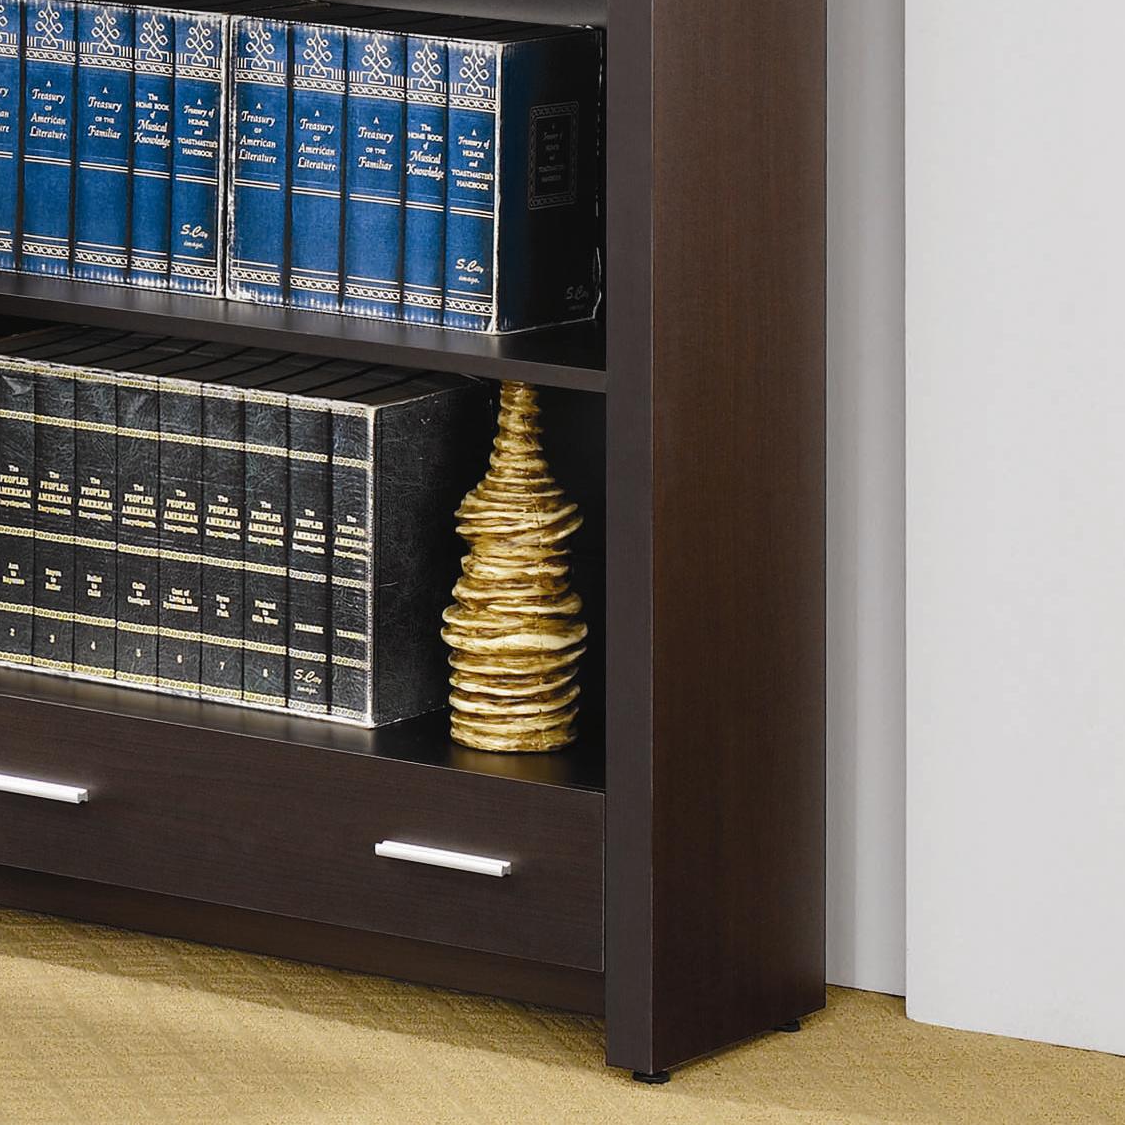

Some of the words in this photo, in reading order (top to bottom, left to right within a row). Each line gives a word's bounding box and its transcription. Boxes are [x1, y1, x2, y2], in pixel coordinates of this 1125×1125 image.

[32, 88, 66, 104] Treasury
[88, 96, 122, 113] Treasury
[30, 112, 66, 125] American
[241, 110, 275, 127] Treasury
[373, 116, 379, 125] A
[29, 125, 67, 140] Literature
[88, 125, 121, 139] Familiar
[137, 119, 168, 133] Musical
[299, 118, 335, 135] Treasury
[134, 132, 171, 149] Knowledge
[239, 135, 276, 148] American
[358, 126, 394, 144] Treasury
[298, 142, 336, 156] American
[238, 148, 277, 164] Literature
[409, 150, 442, 165] Musical
[297, 156, 337, 172] Literature
[358, 156, 394, 171] Familiar
[406, 164, 445, 181] Knowledge
[0, 474, 29, 486] PEOPLES
[40, 480, 69, 493] PEOPLES
[38, 492, 72, 505] AMERICAN
[81, 486, 110, 499] PEOPLES
[124, 493, 154, 505] PEOPLES
[78, 498, 113, 511] AMERICAN
[166, 499, 196, 511] PEOPLES
[208, 504, 238, 517] PEOPLES
[122, 505, 156, 518] AMERICAN
[163, 510, 198, 523] AMERICAN
[250, 510, 281, 523] PEOPLES
[205, 516, 241, 530] AMERICAN
[248, 522, 284, 536] AMERICAN
[295, 518, 324, 530] PEOPLES
[293, 530, 326, 543] AMERICAN
[9, 627, 15, 637] 2
[49, 634, 55, 644] 3
[219, 661, 226, 671] 7
